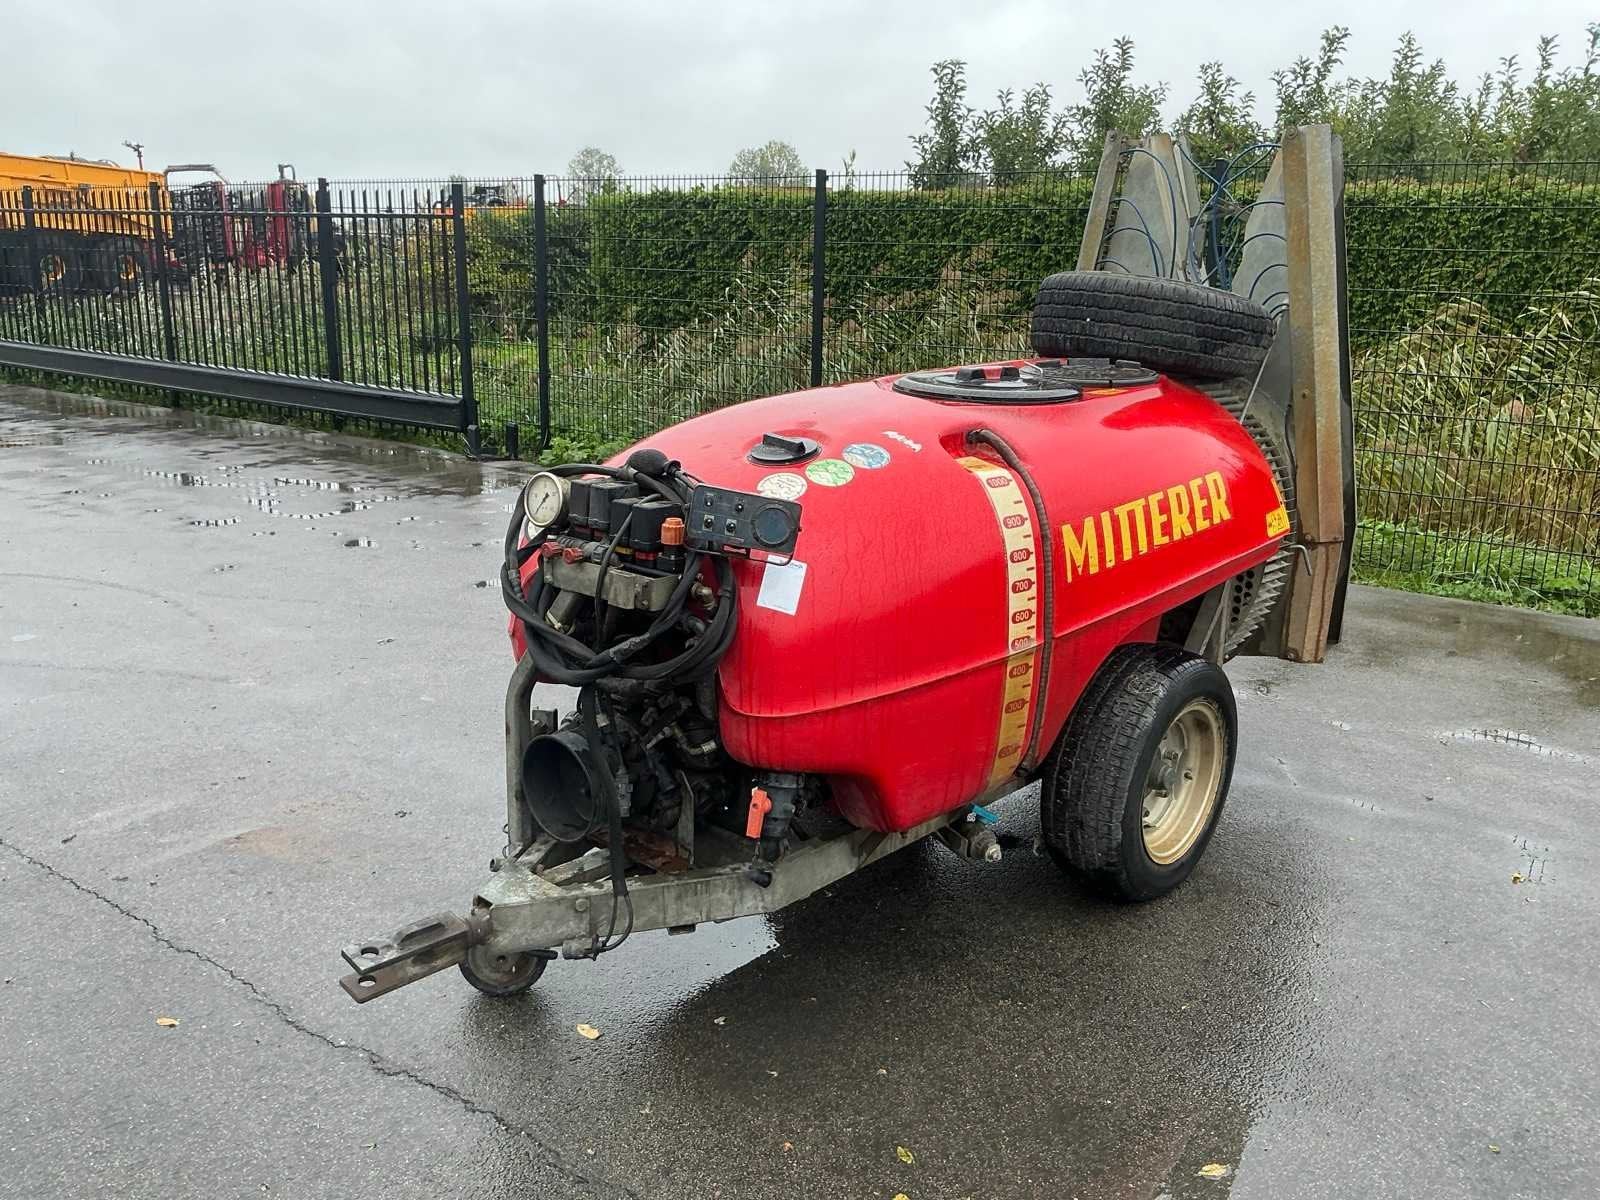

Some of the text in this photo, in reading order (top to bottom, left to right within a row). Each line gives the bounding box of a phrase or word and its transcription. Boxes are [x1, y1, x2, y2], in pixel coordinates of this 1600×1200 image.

[1007, 516, 1021, 527] 900
[1061, 471, 1231, 583] MITTERER
[1013, 550, 1027, 562] 800
[1015, 580, 1029, 592] 700
[1015, 610, 1029, 622] 600
[1012, 665, 1026, 676] 400
